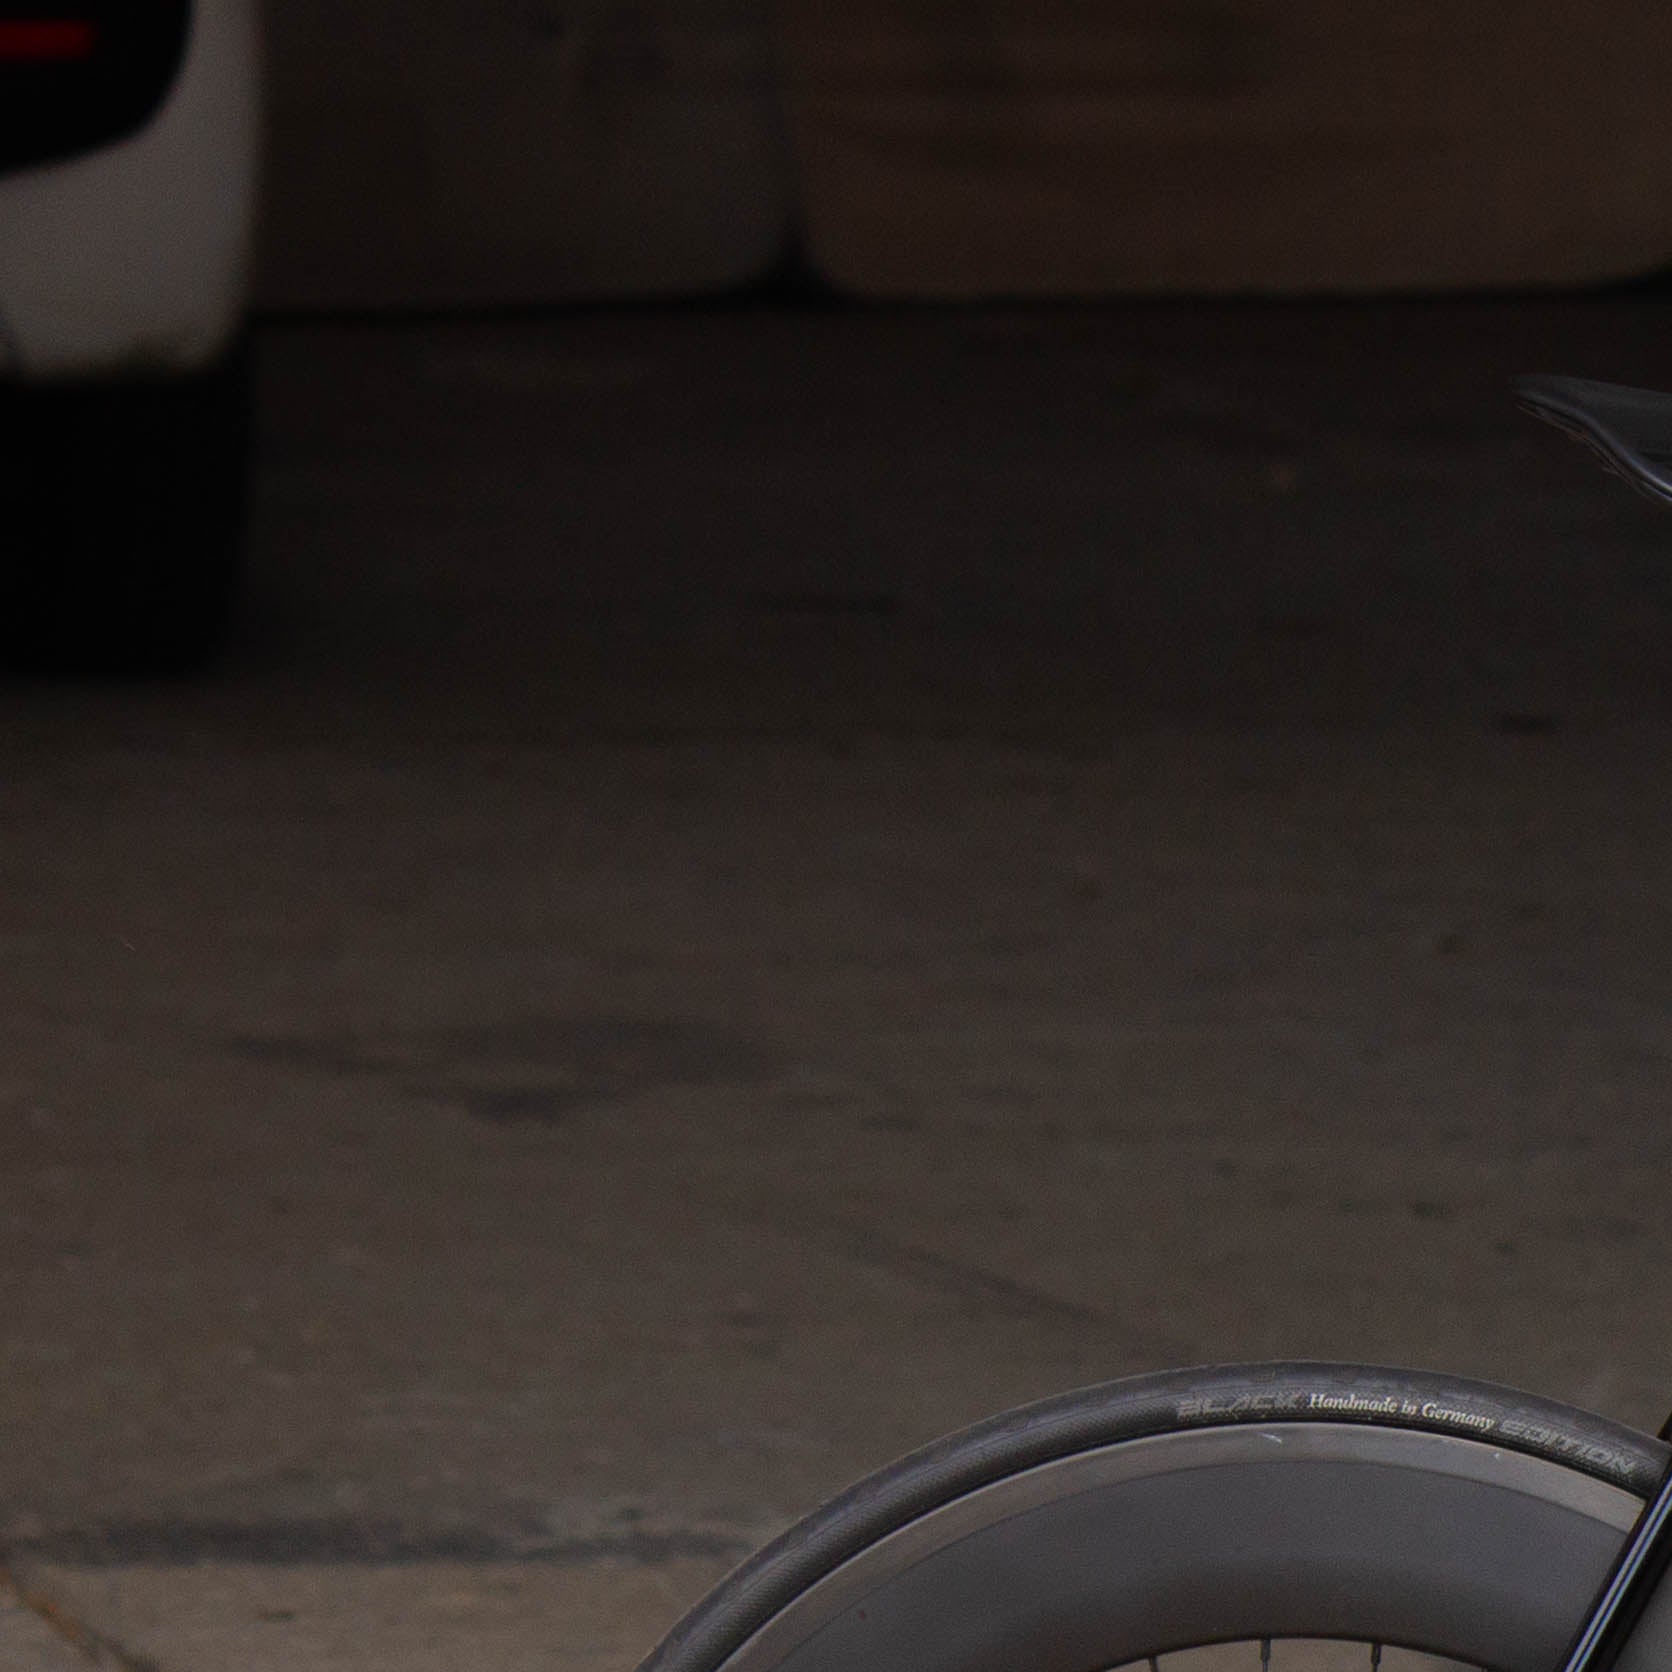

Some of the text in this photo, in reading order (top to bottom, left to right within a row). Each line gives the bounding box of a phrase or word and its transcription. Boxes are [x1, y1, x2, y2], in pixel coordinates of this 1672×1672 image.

[1308, 1393, 1496, 1432] Handmade in Germany
